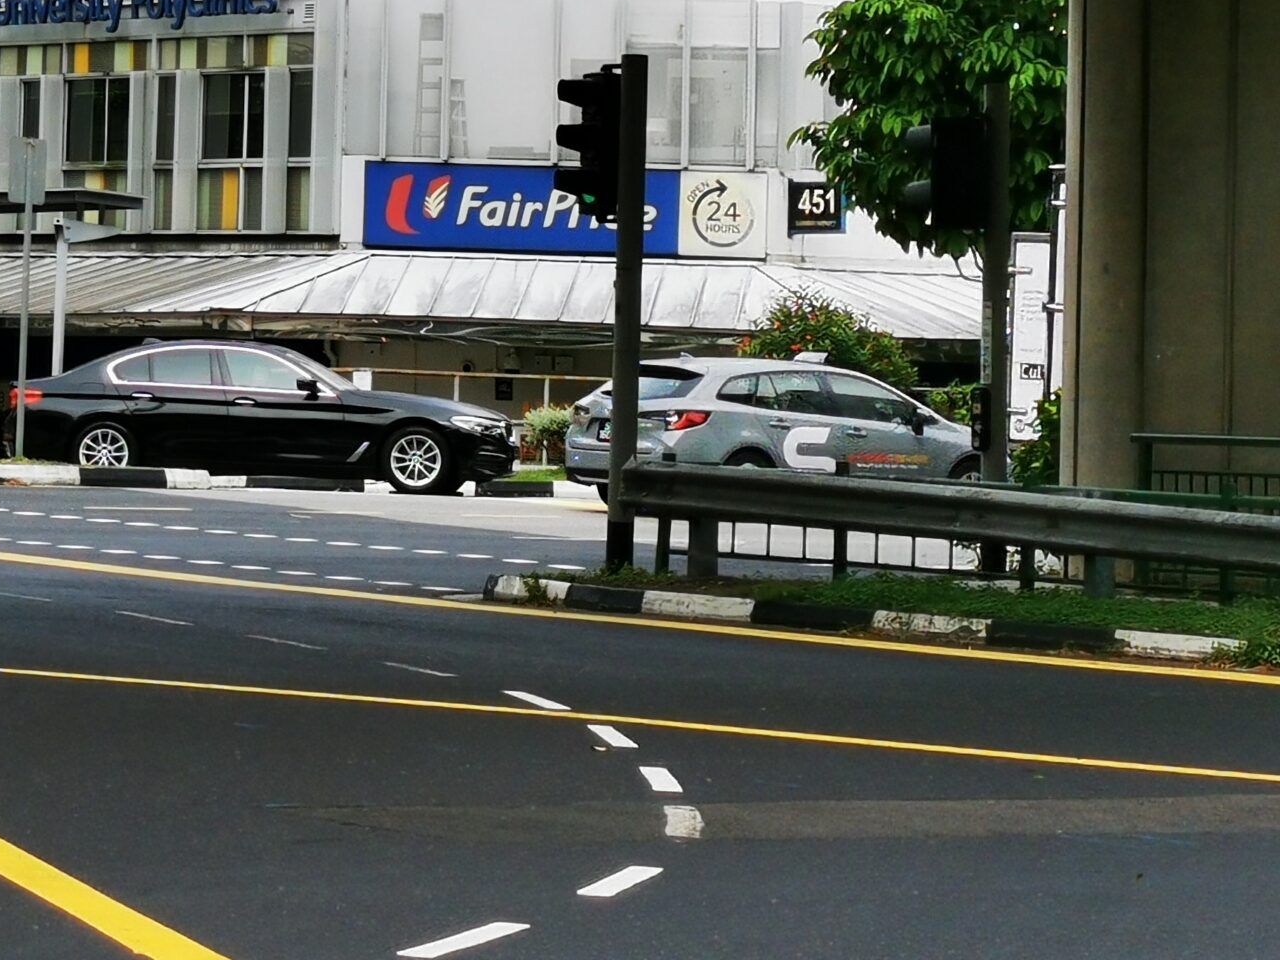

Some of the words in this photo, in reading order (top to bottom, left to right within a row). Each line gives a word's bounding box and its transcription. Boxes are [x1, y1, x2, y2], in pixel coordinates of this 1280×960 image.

[687, 180, 710, 203] OPEN
[798, 188, 835, 215] 451
[706, 200, 741, 222] 24
[705, 223, 741, 234] HOURS
